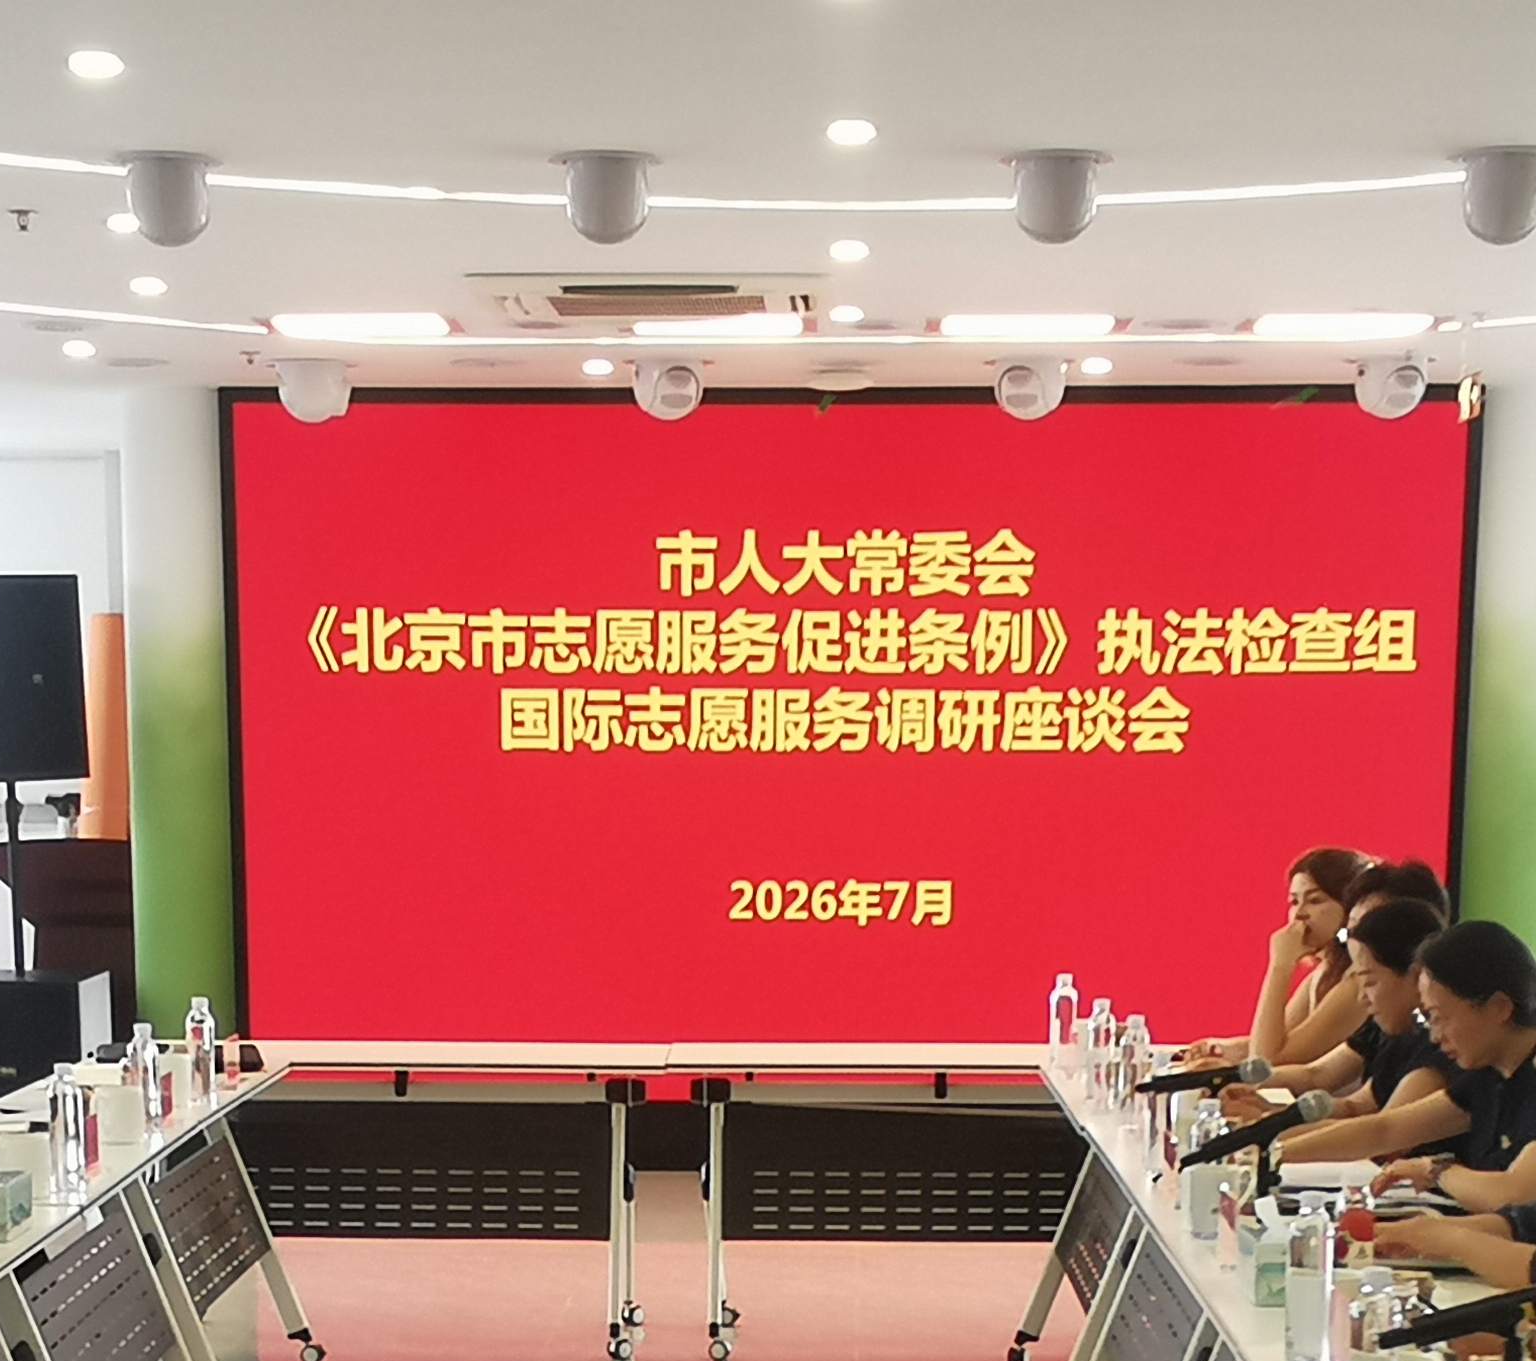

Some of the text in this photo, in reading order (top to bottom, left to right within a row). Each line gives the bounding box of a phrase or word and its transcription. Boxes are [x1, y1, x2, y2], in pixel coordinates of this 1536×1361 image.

[655, 528, 1036, 598] 市人大常委会
[307, 605, 1418, 676] 《北京市志愿服务促进条例》执法检查组
[500, 685, 1191, 754] 国际志愿服务调研座谈会
[728, 878, 952, 927] 2026年7月
